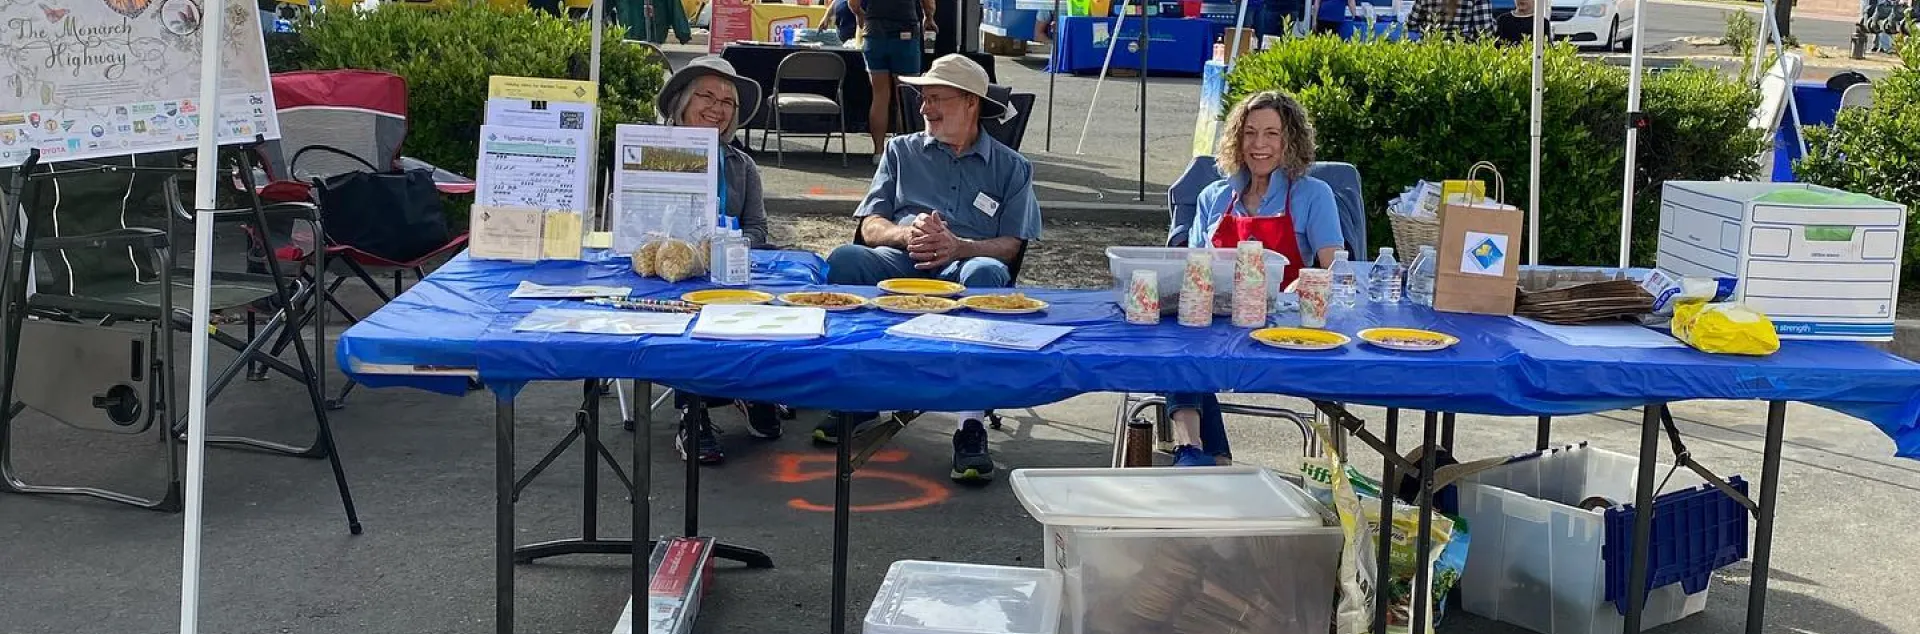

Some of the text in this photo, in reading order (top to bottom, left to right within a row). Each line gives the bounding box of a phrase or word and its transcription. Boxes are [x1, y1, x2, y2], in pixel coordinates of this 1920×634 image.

[8, 15, 132, 43] The Monarch
[45, 41, 126, 80] Highway
[40, 146, 66, 155] OYOTA
[1779, 323, 1811, 334] strength
[770, 450, 948, 512] 5
